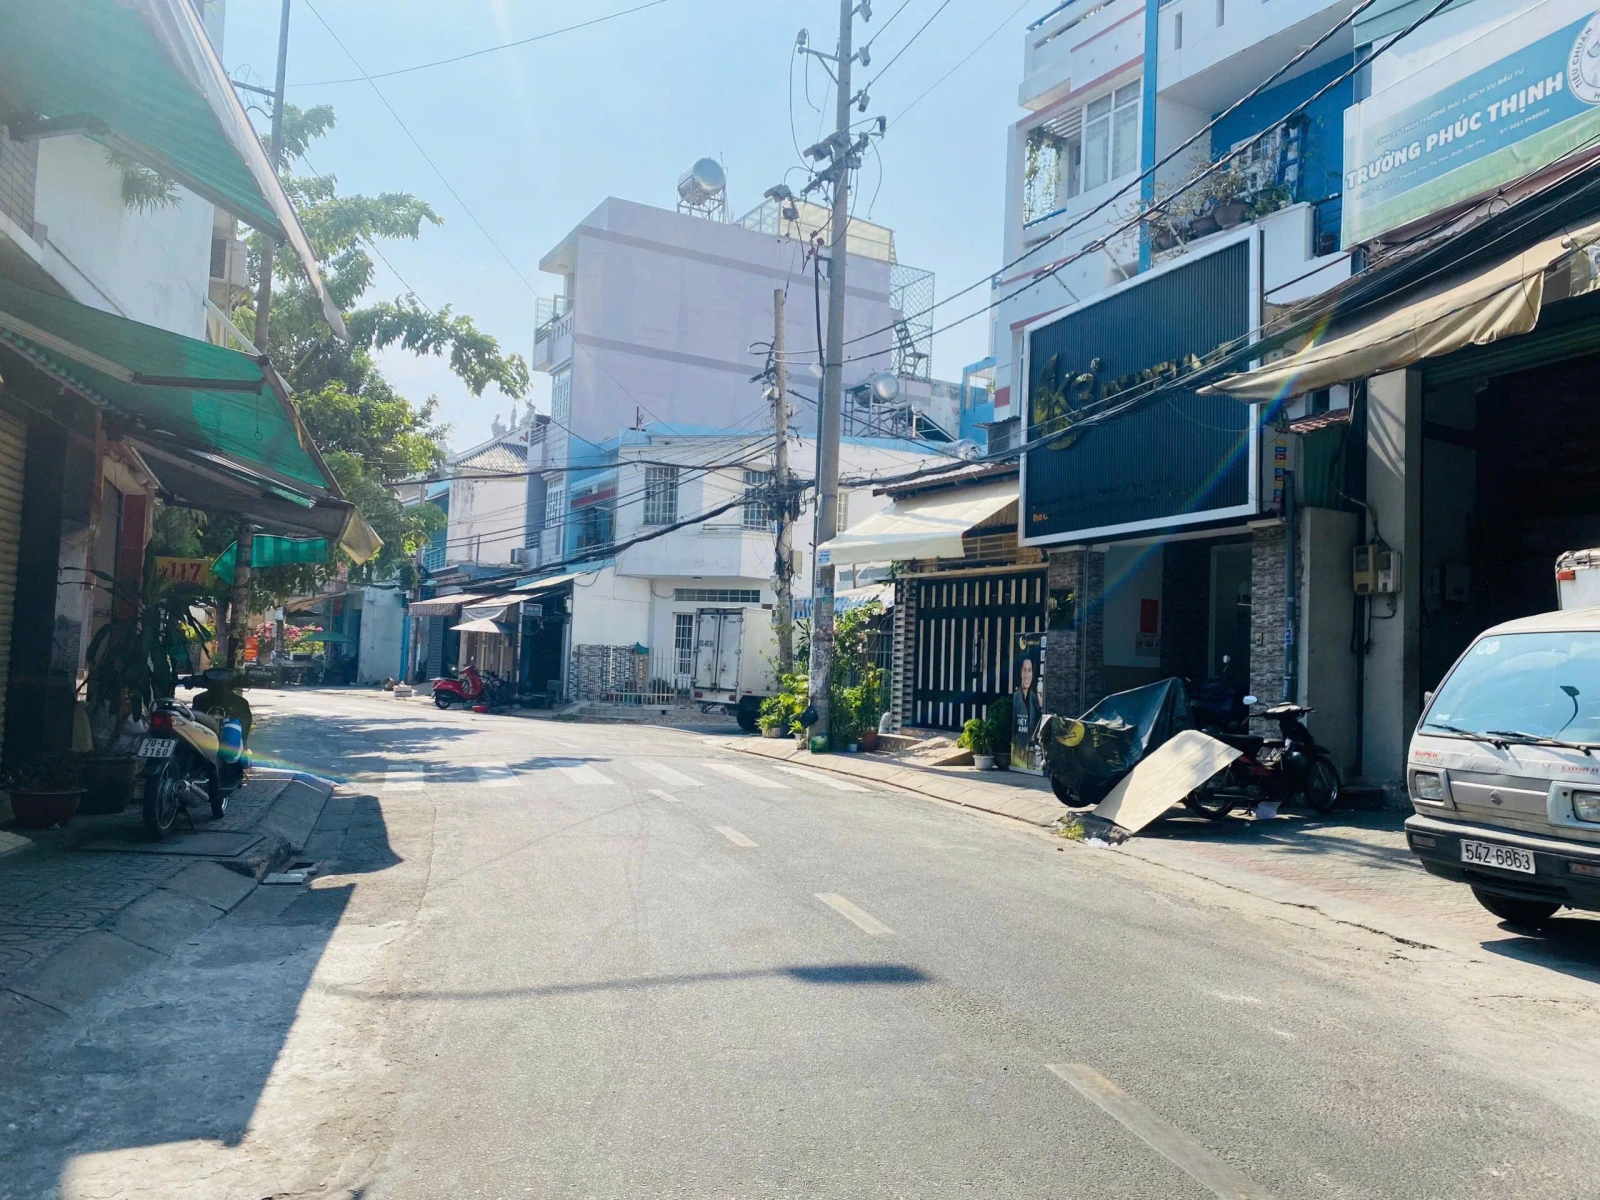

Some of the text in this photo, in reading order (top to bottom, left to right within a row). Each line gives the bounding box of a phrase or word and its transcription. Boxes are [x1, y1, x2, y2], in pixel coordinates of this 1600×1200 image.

[1345, 140, 1421, 190] TRƯỜNG
[1425, 111, 1482, 153] PHÚC
[1487, 71, 1563, 123] THỊNH
[169, 561, 202, 581] 117
[142, 748, 169, 757] 3160
[145, 739, 172, 748] 70-K3
[1465, 843, 1531, 871] 54Z-6863
